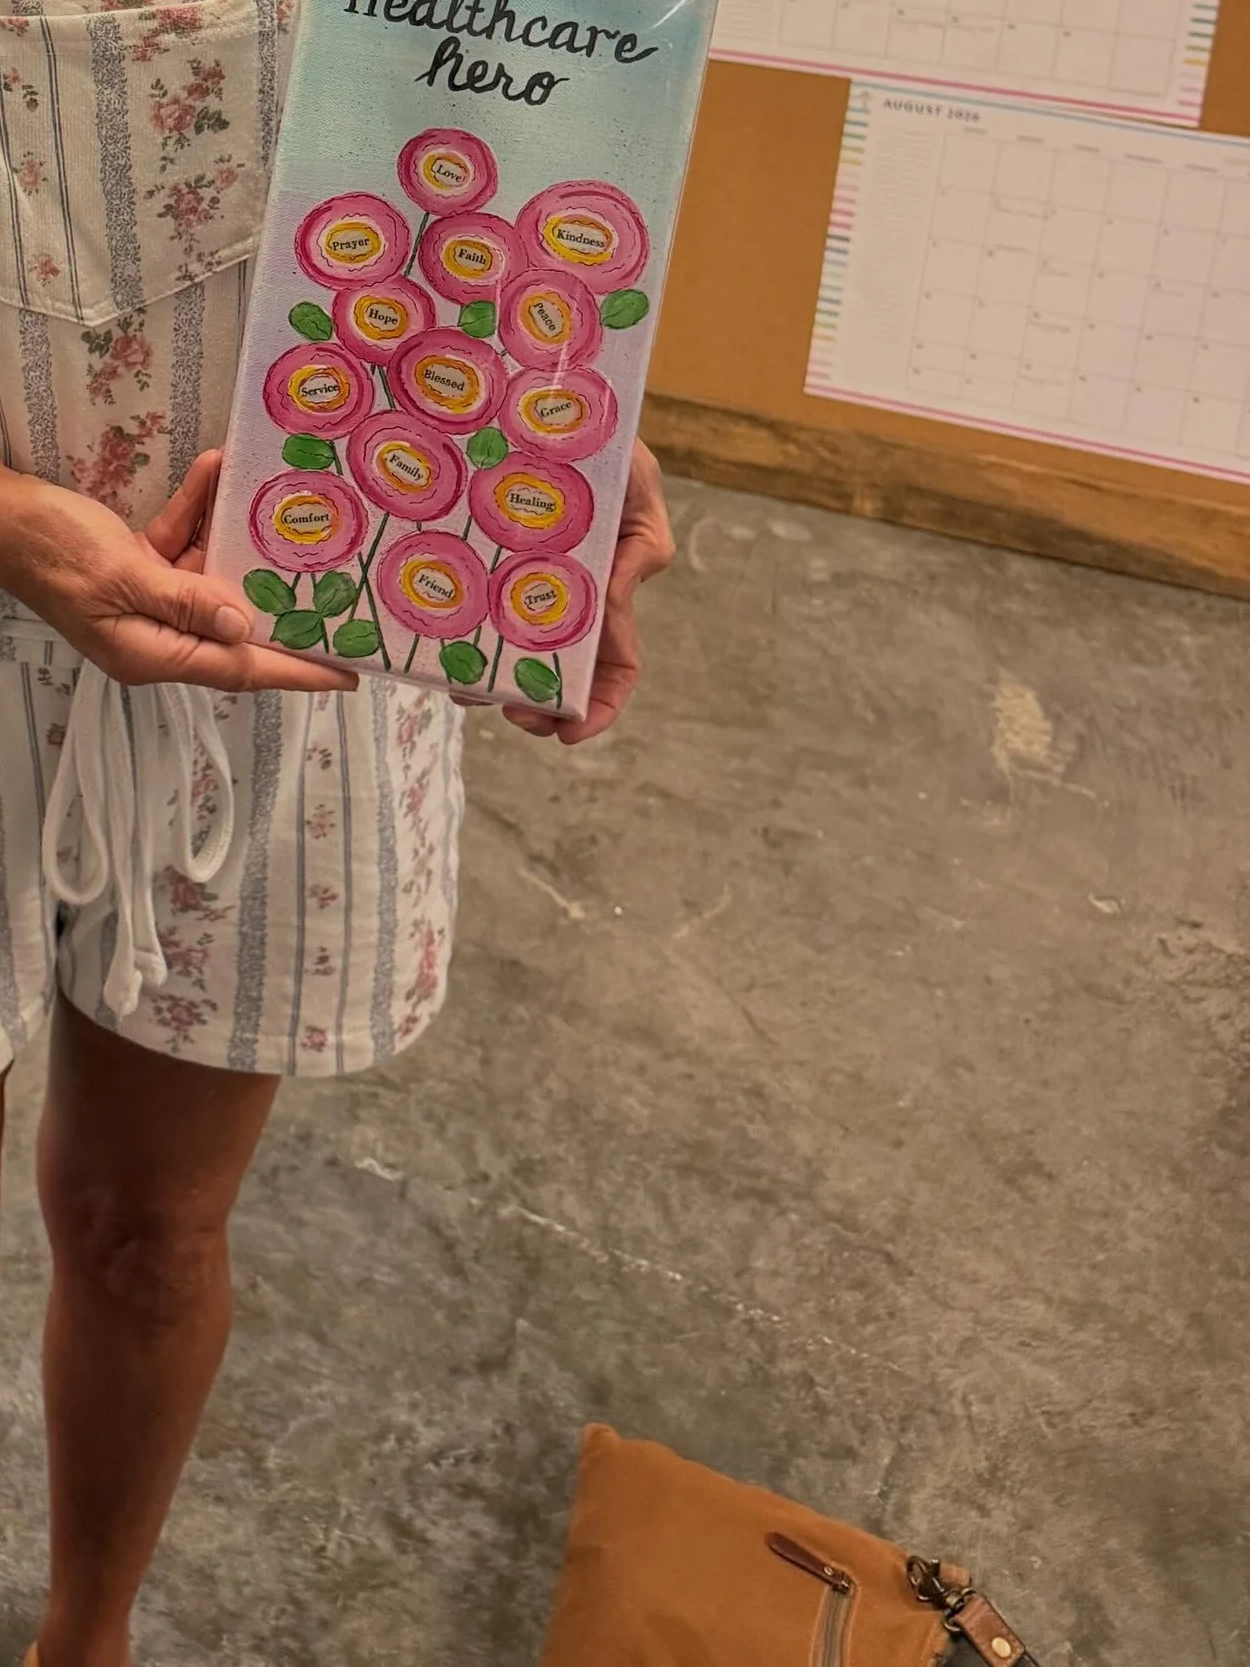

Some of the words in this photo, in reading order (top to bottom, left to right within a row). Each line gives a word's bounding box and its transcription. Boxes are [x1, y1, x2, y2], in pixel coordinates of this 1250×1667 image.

[415, 36, 570, 107] hero
[882, 97, 943, 118] AUGUST
[435, 164, 463, 183] Love
[331, 235, 370, 252] Prayer
[556, 228, 606, 249] Kindness
[458, 248, 487, 267] Faith
[368, 307, 399, 326] Hope
[535, 302, 557, 332] Peace
[422, 367, 466, 392] Blessed
[301, 382, 340, 398] Service
[539, 400, 572, 419] Grace
[388, 453, 425, 482] Family
[509, 492, 555, 513] Healing
[283, 511, 330, 526] Comfort
[418, 572, 455, 600] Friend
[525, 589, 557, 606] Trust
